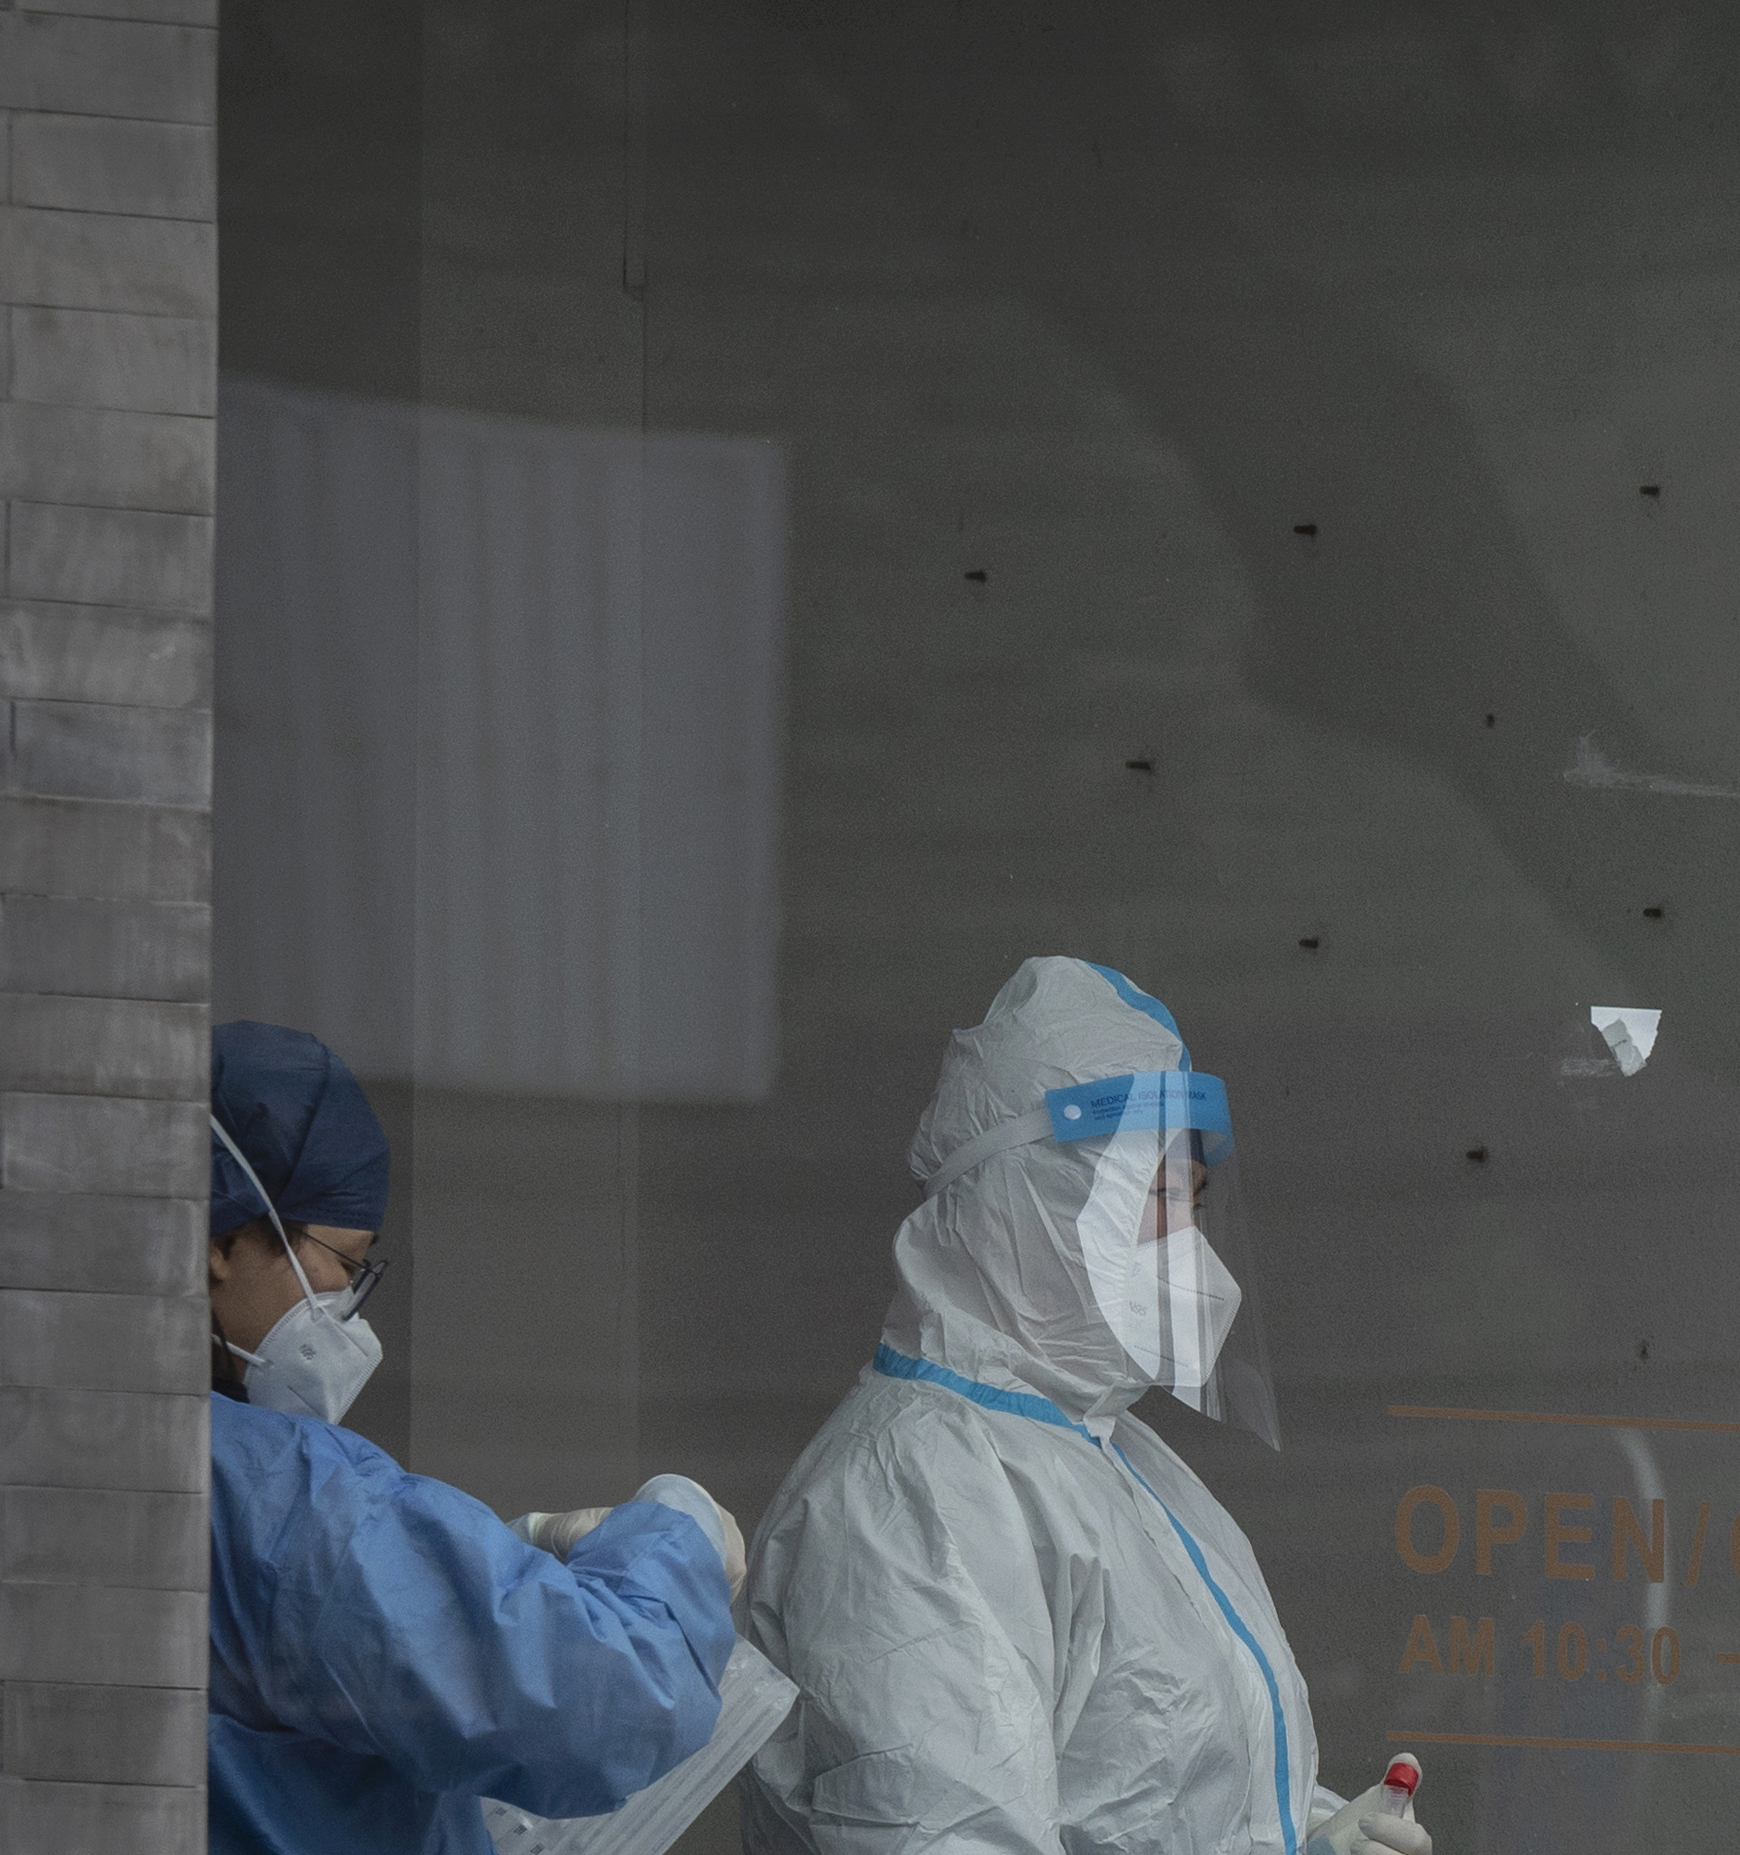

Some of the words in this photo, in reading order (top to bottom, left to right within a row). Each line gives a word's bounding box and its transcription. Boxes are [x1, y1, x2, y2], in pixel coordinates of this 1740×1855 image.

[1090, 1093, 1133, 1109] MEDICAL
[1400, 1615, 1497, 1676] AM
[1523, 1618, 1681, 1686] 10:30
